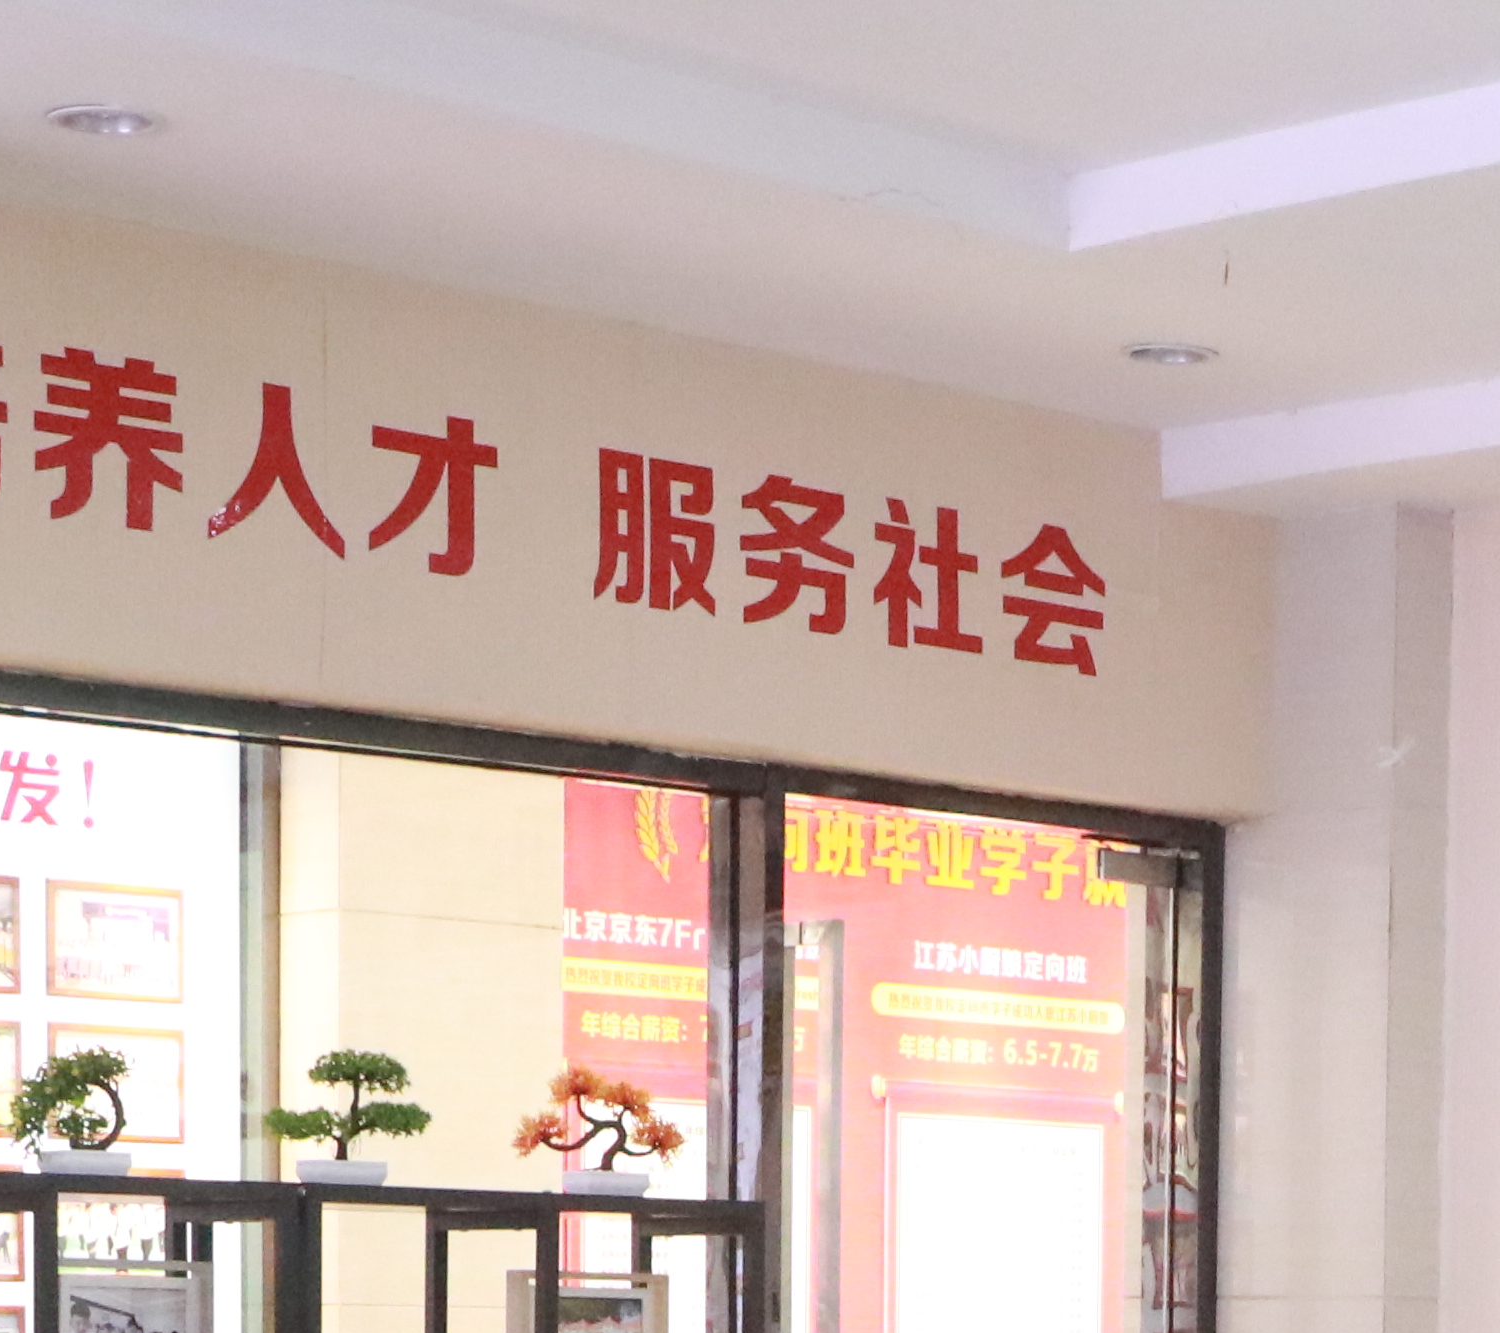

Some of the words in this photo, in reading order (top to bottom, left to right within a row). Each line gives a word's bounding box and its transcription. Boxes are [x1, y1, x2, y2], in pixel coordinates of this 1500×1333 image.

[592, 446, 1106, 678] 服务社会
[913, 940, 1088, 984] 江苏小厨娘定向班
